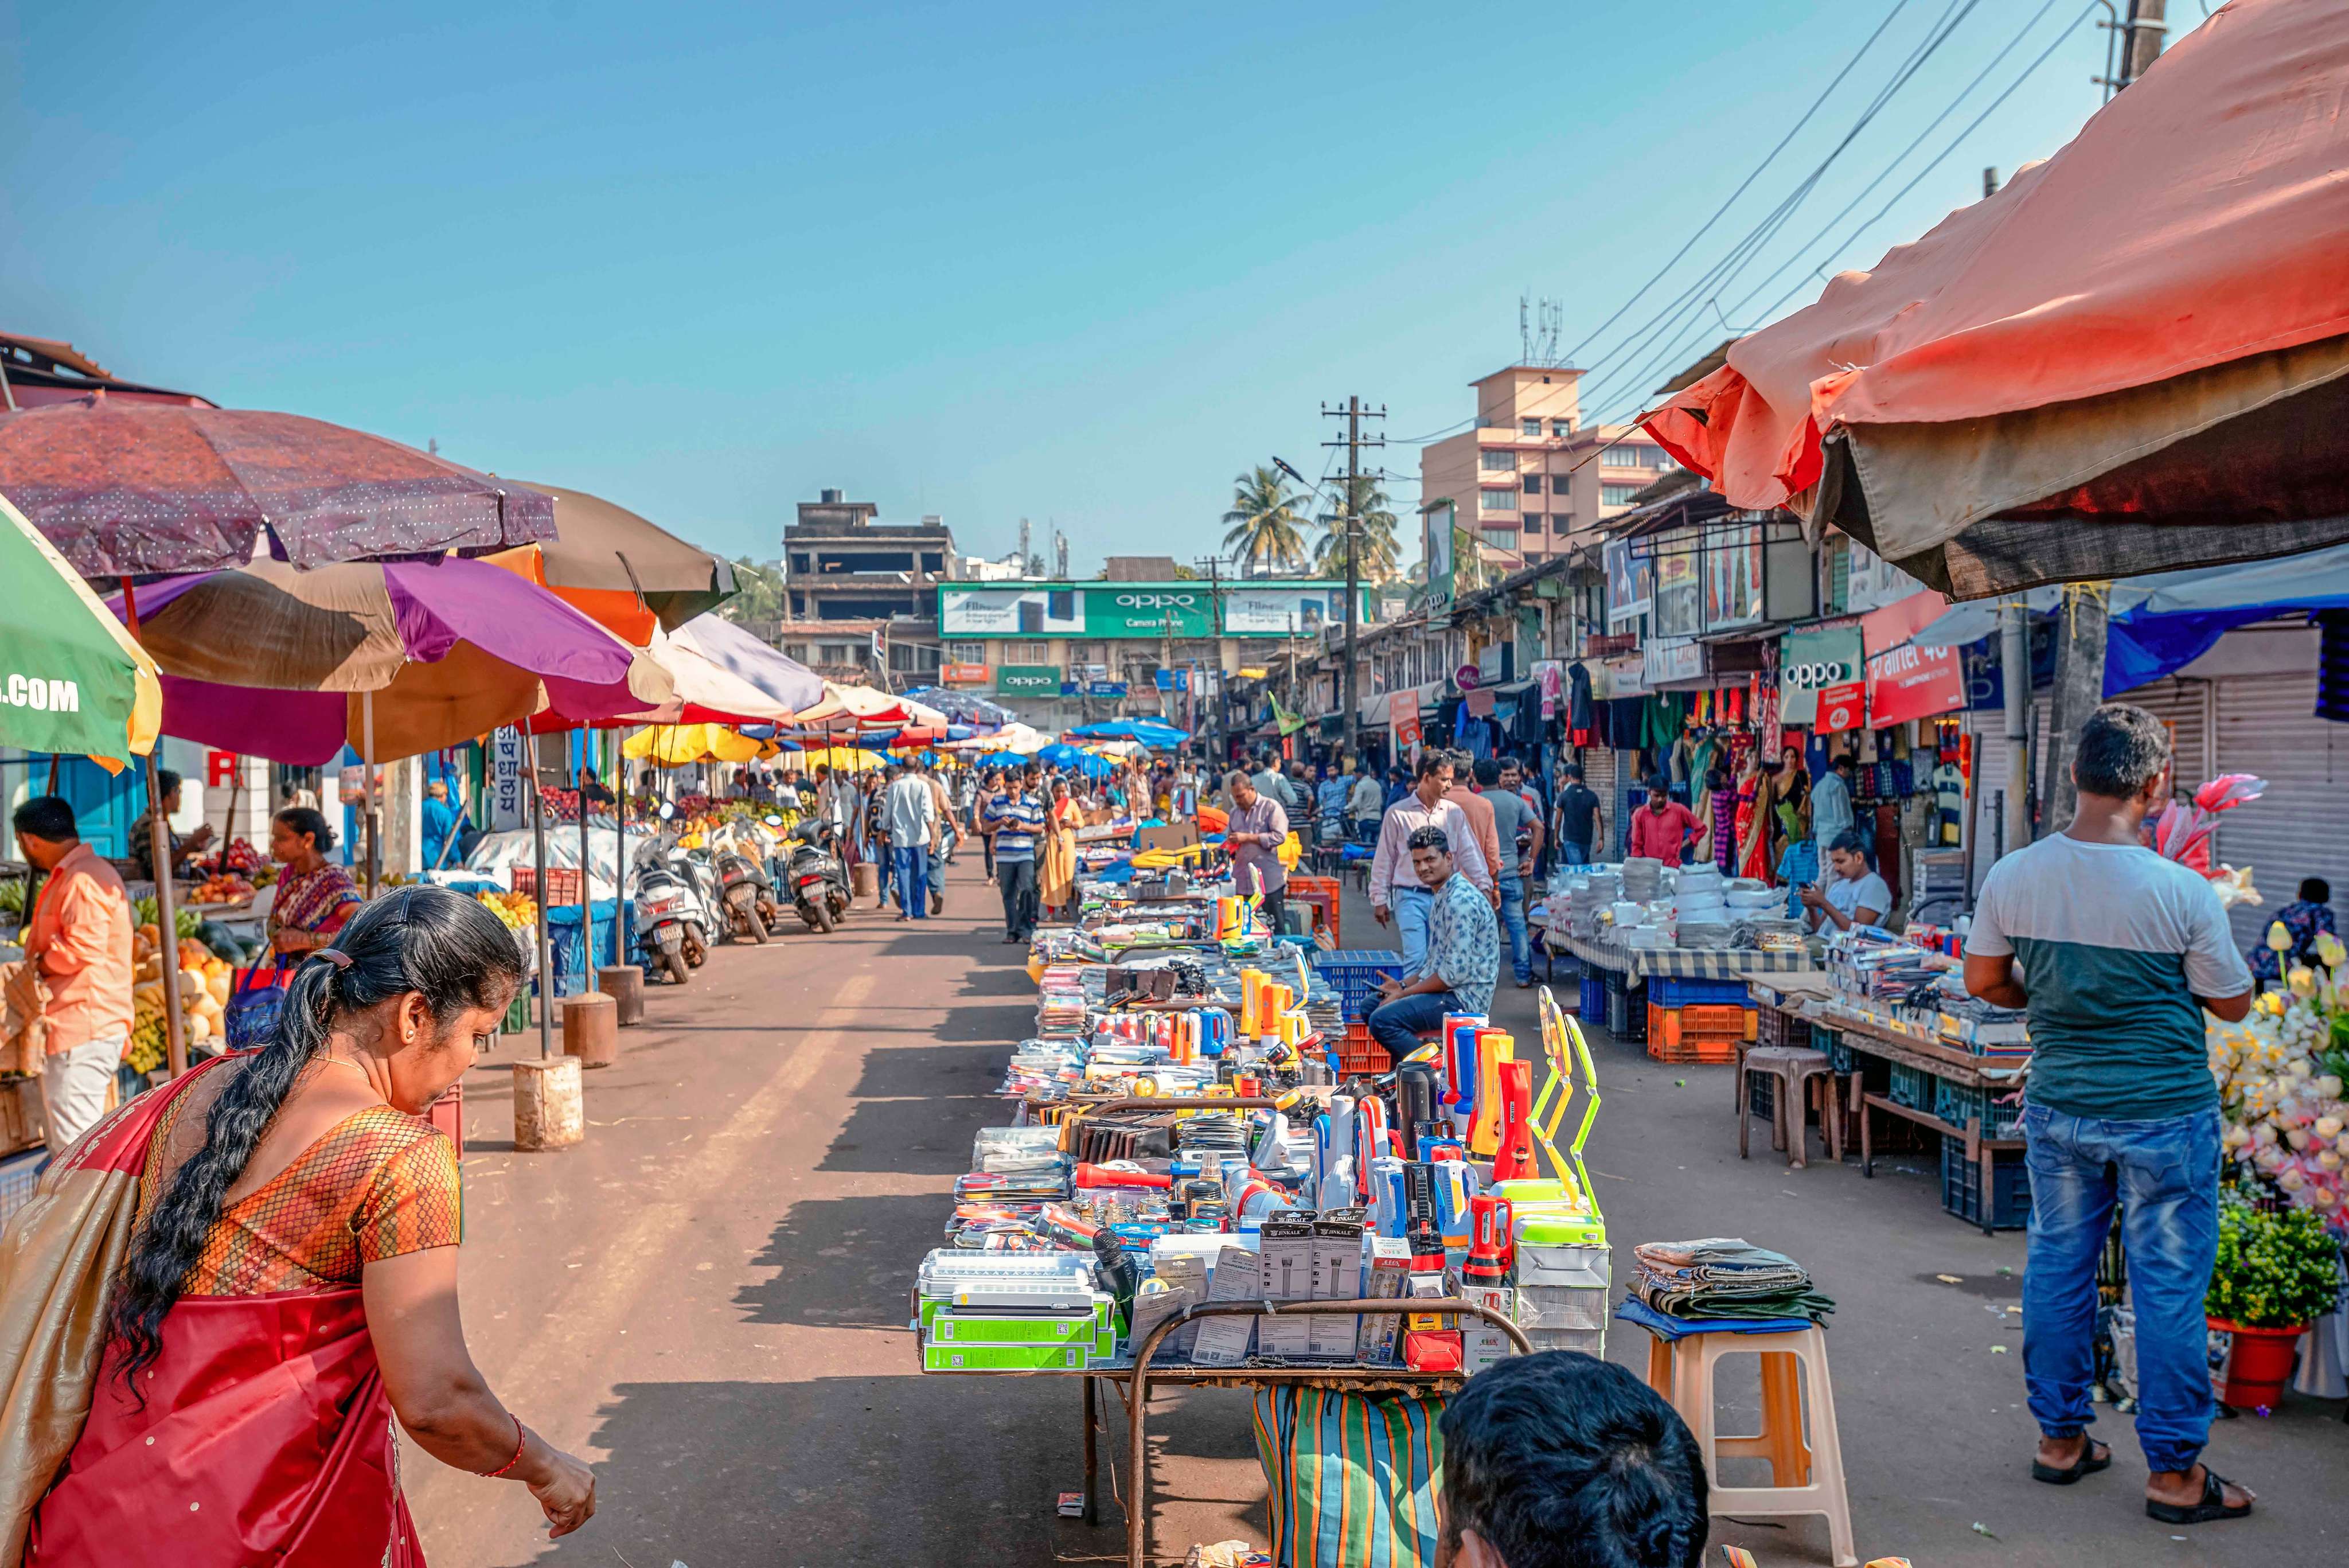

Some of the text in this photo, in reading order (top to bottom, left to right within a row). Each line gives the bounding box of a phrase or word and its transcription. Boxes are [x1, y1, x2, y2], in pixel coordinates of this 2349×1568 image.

[1126, 618, 1157, 628] Camera
[1459, 670, 1478, 685] Jio
[0, 673, 79, 712] .COM
[209, 751, 243, 787] R
